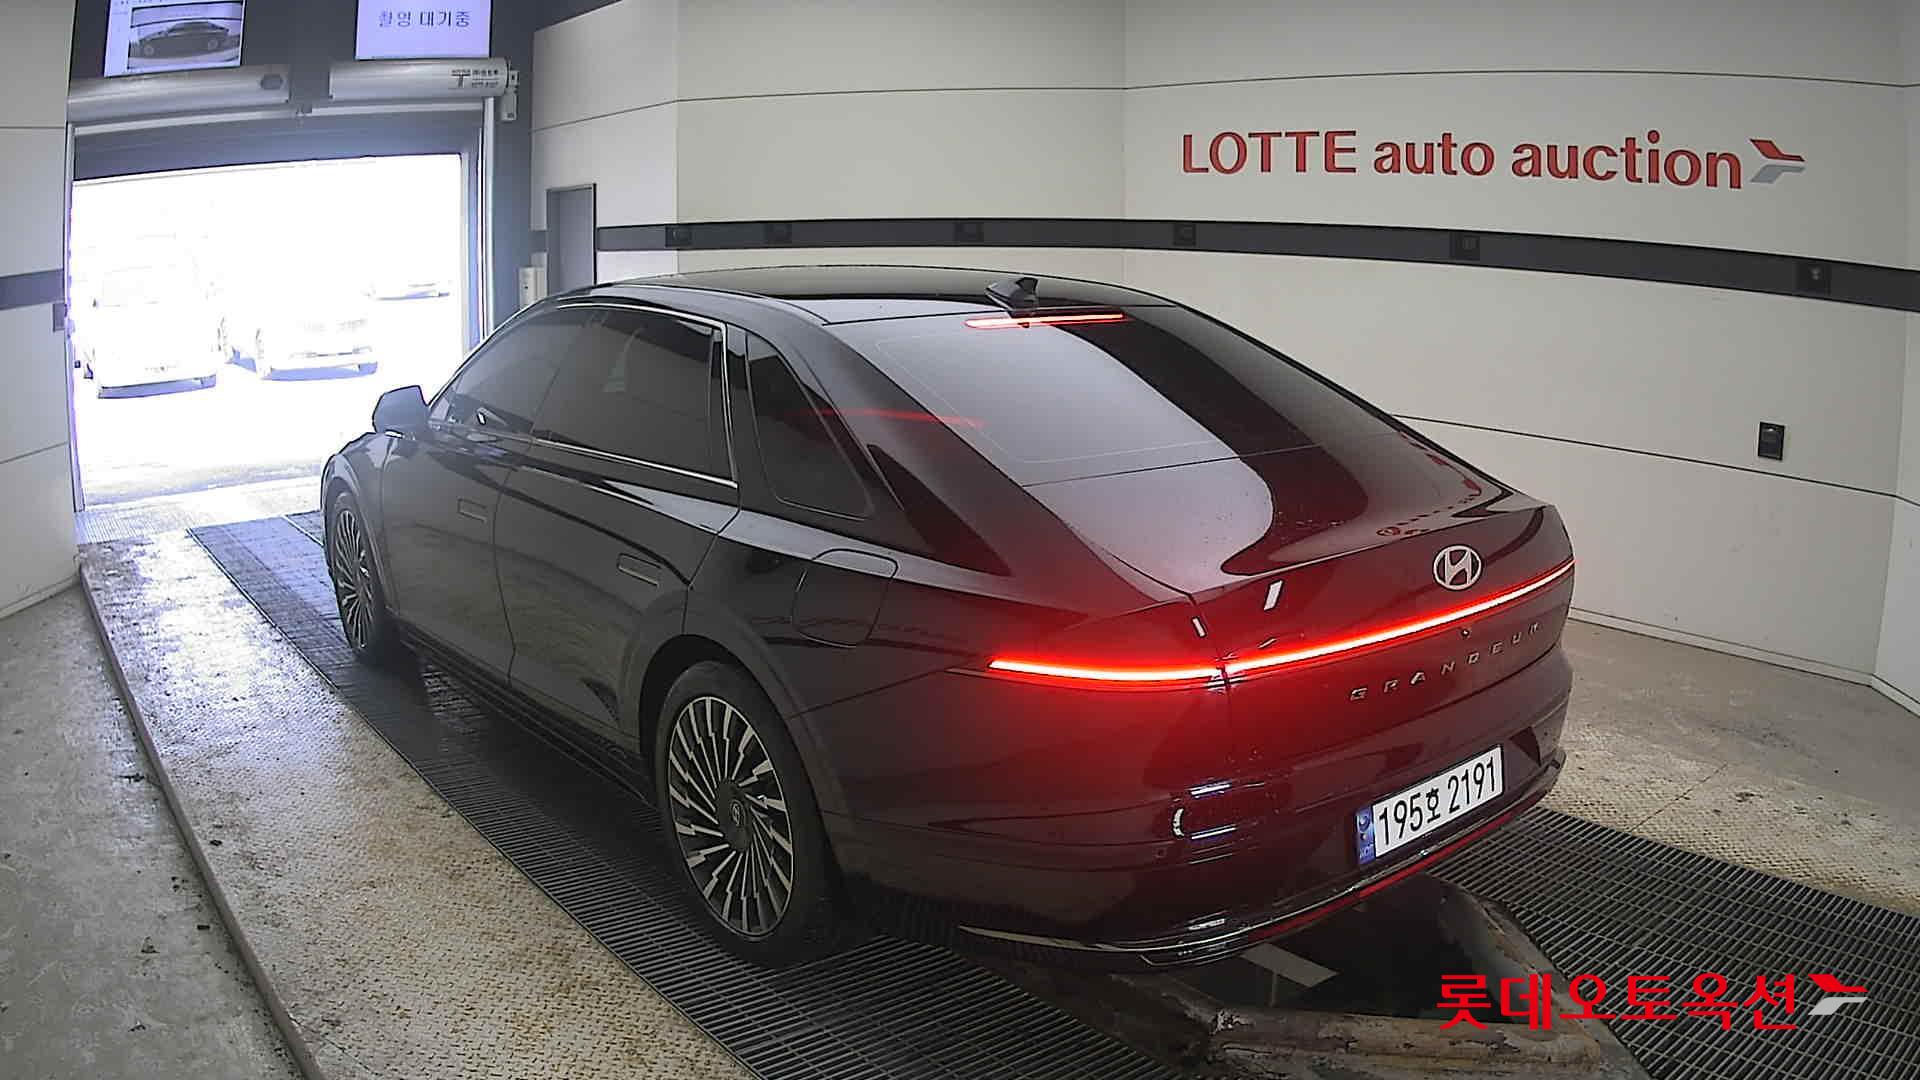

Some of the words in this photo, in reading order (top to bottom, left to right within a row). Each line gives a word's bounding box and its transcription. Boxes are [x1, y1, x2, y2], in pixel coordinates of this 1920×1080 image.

[419, 10, 470, 28] 대기중
[1182, 130, 1357, 174] LOTTE
[1374, 132, 1495, 176] auto
[1512, 130, 1742, 189] auction
[1447, 756, 1496, 814] 2191
